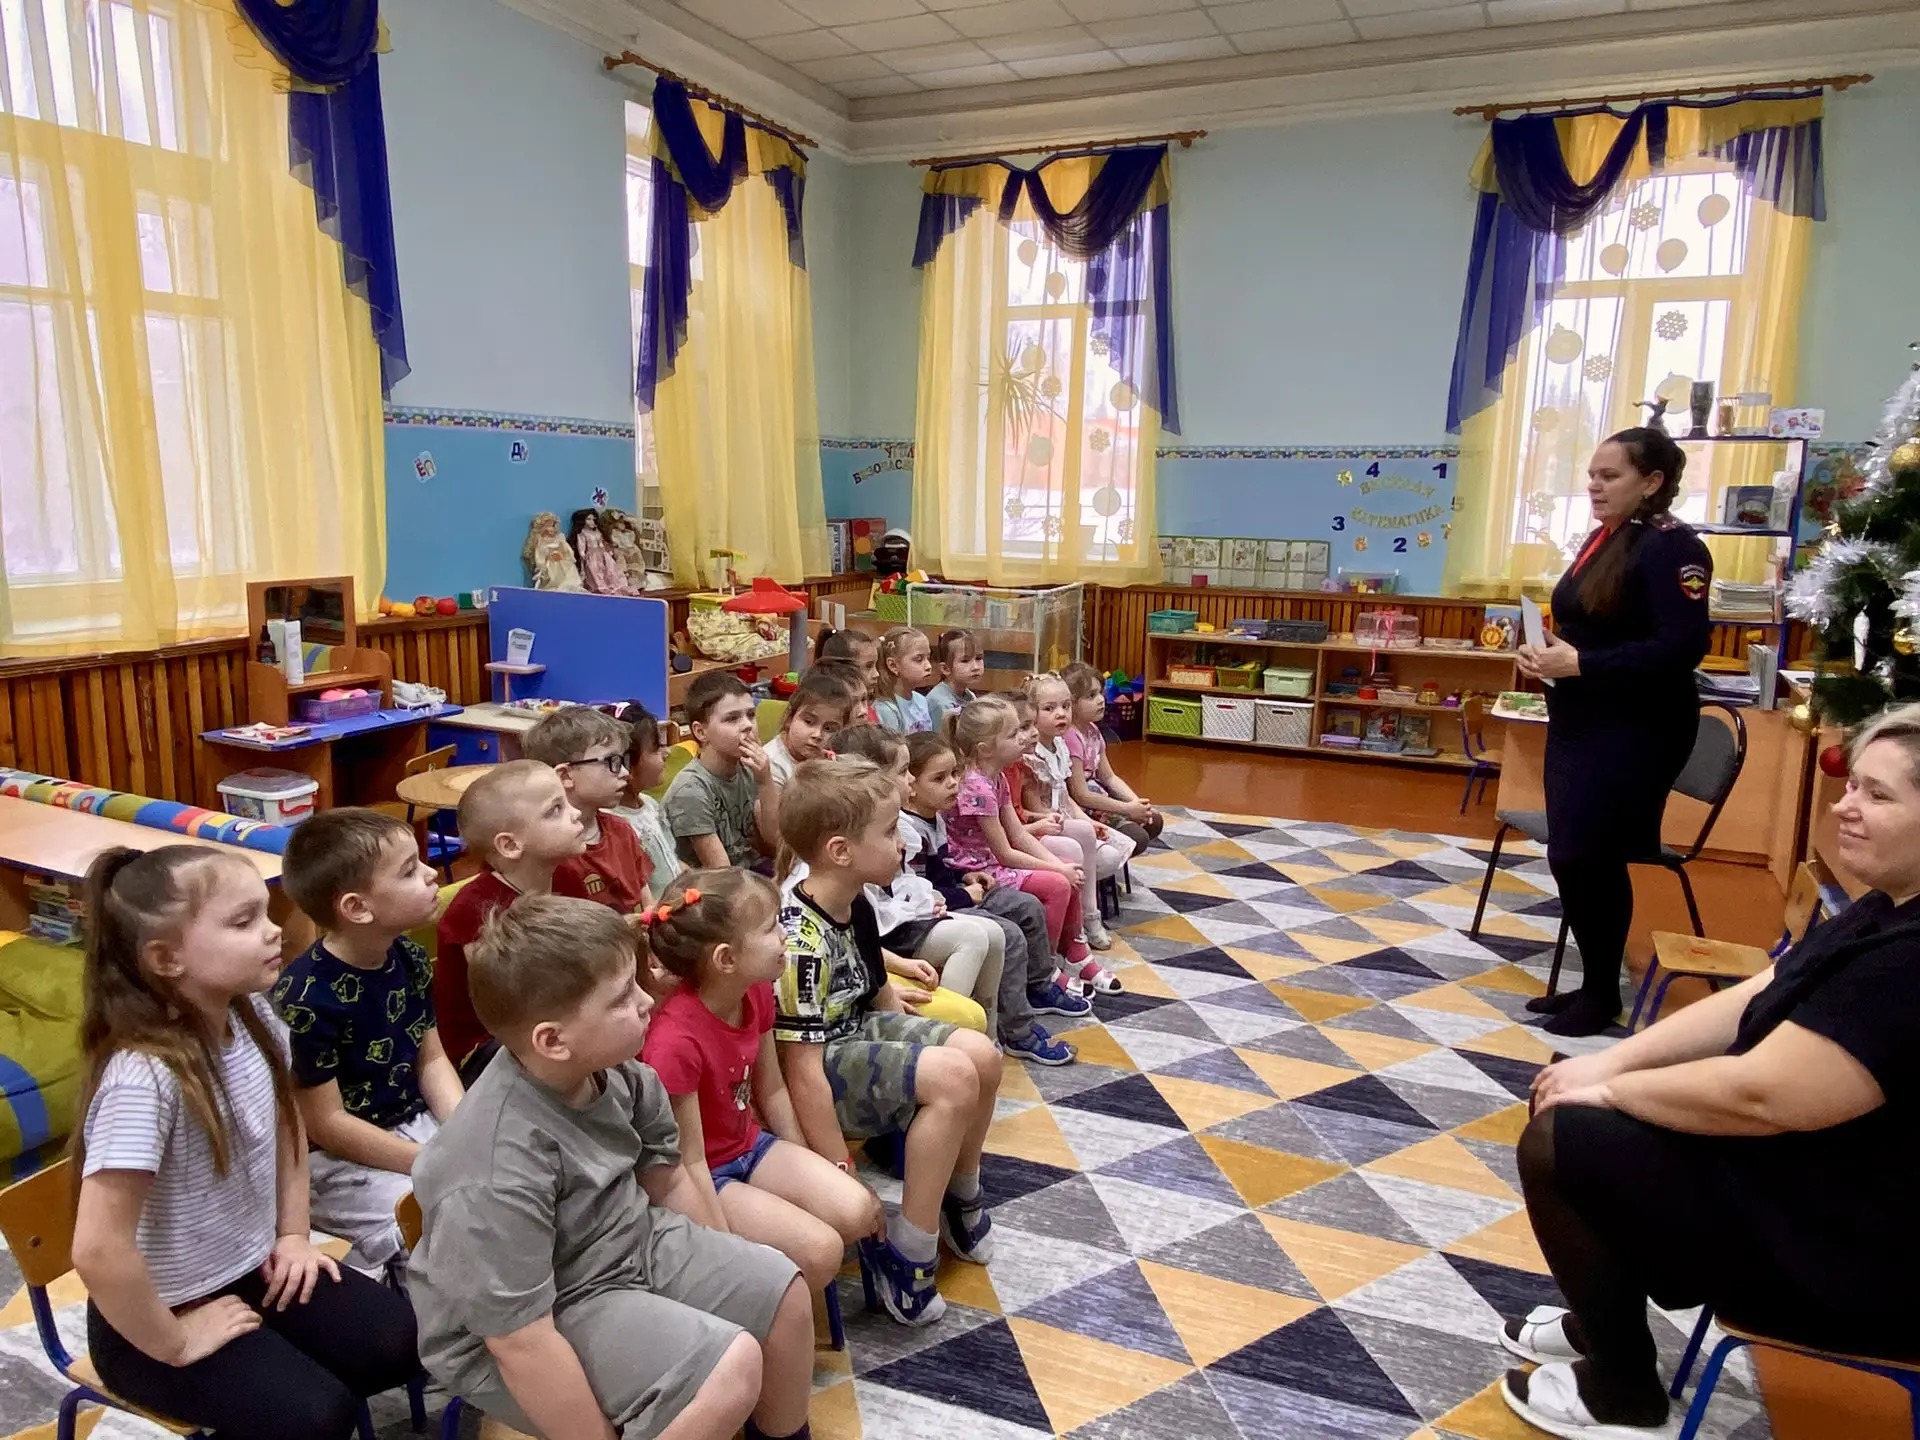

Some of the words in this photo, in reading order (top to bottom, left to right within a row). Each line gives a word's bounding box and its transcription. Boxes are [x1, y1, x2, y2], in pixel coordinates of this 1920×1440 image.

[1366, 461, 1380, 478] 4
[1432, 463, 1447, 479] 1
[1450, 496, 1465, 512] 5
[1331, 515, 1345, 531] 3
[1393, 537, 1407, 553] 2
